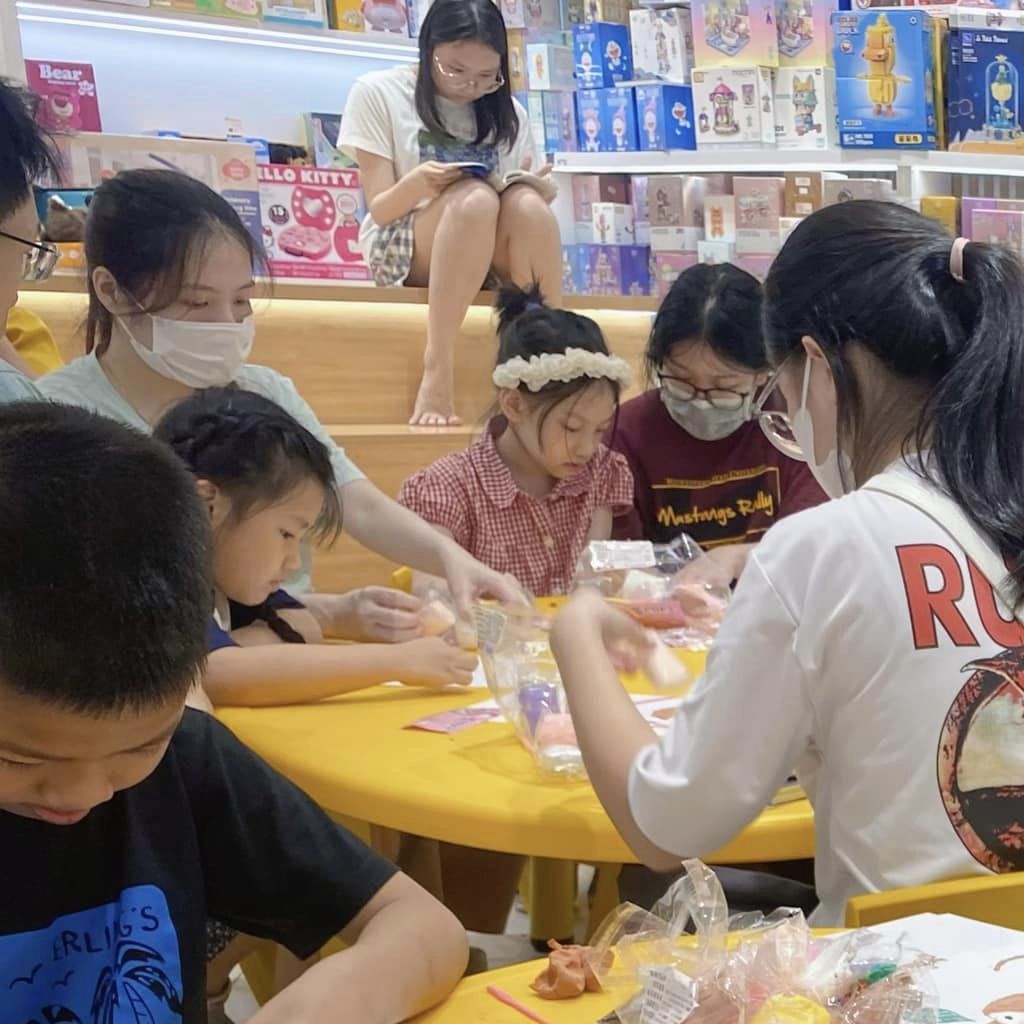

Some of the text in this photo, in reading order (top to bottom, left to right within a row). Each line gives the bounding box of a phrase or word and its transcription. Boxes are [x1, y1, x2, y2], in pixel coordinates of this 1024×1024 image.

[39, 64, 82, 80] Bear
[301, 170, 353, 186] KITTY
[736, 489, 774, 516] Rally
